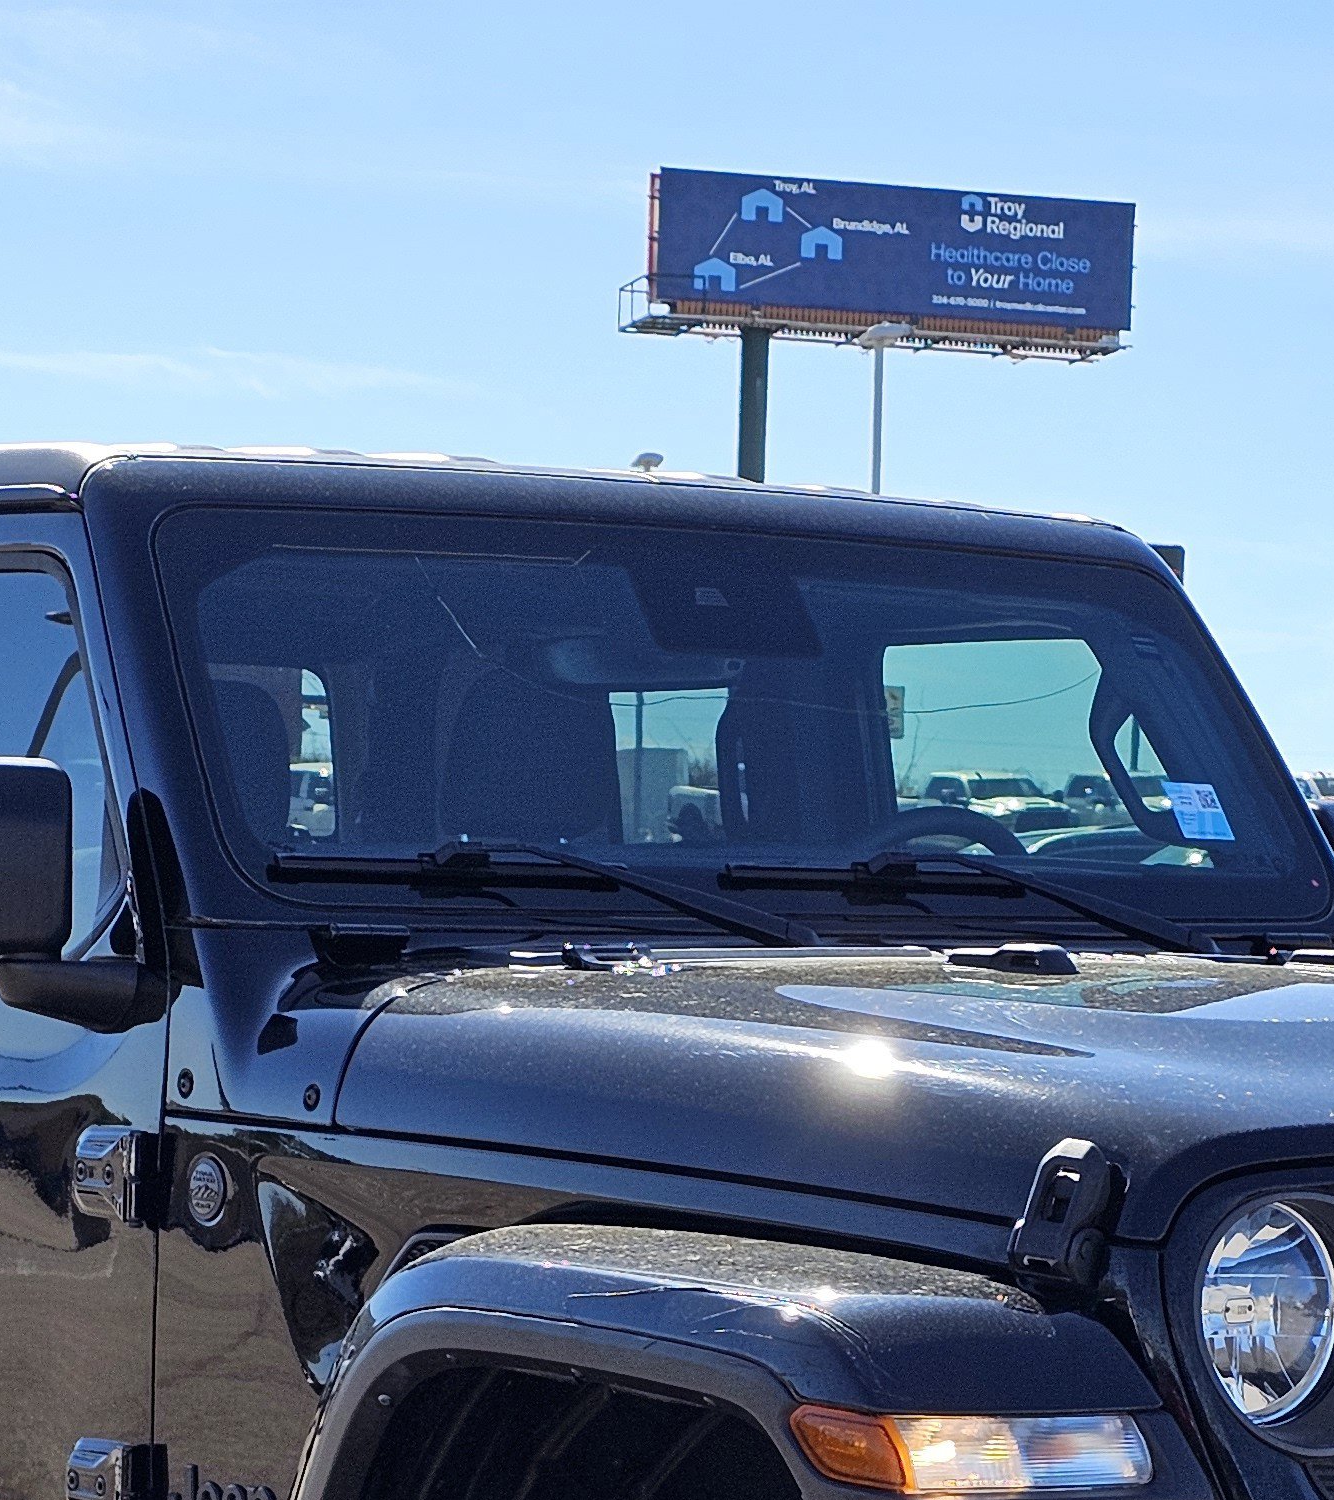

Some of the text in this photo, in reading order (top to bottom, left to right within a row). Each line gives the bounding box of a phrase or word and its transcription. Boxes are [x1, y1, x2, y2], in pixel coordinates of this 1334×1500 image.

[986, 197, 1025, 219] Troy
[986, 216, 1064, 240] Regional
[930, 242, 1091, 274] Healthcare Close
[947, 267, 1074, 294] to Your Home
